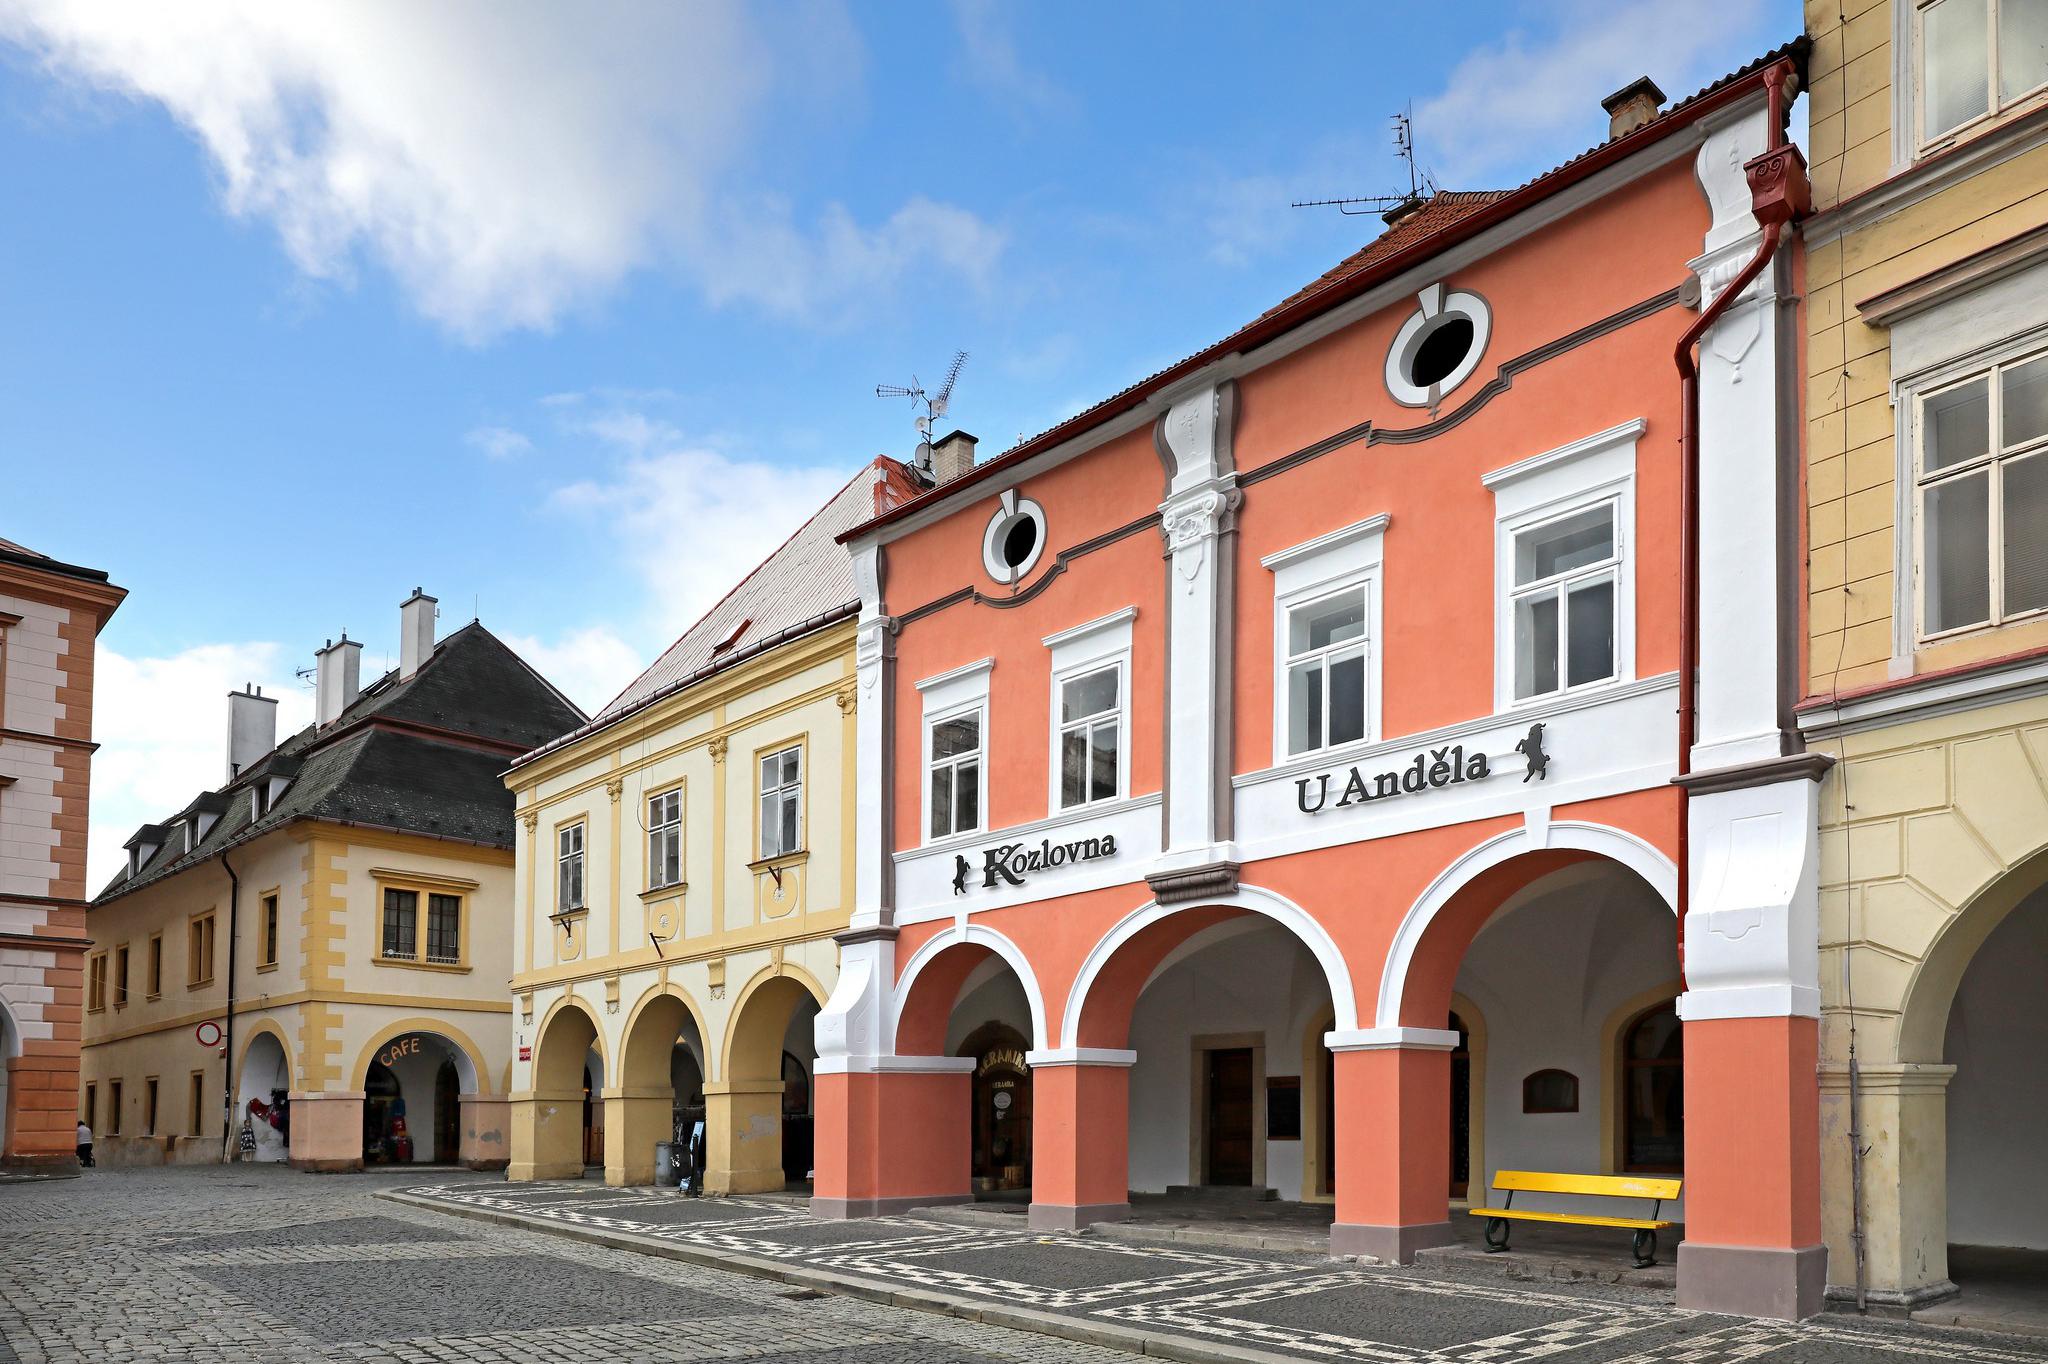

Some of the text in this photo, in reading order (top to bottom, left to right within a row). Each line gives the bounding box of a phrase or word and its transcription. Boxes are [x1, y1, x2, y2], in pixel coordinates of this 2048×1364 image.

[1295, 745, 1491, 813] U Anděla
[982, 835, 1117, 886] Kozlovna
[381, 1038, 420, 1067] CAFE
